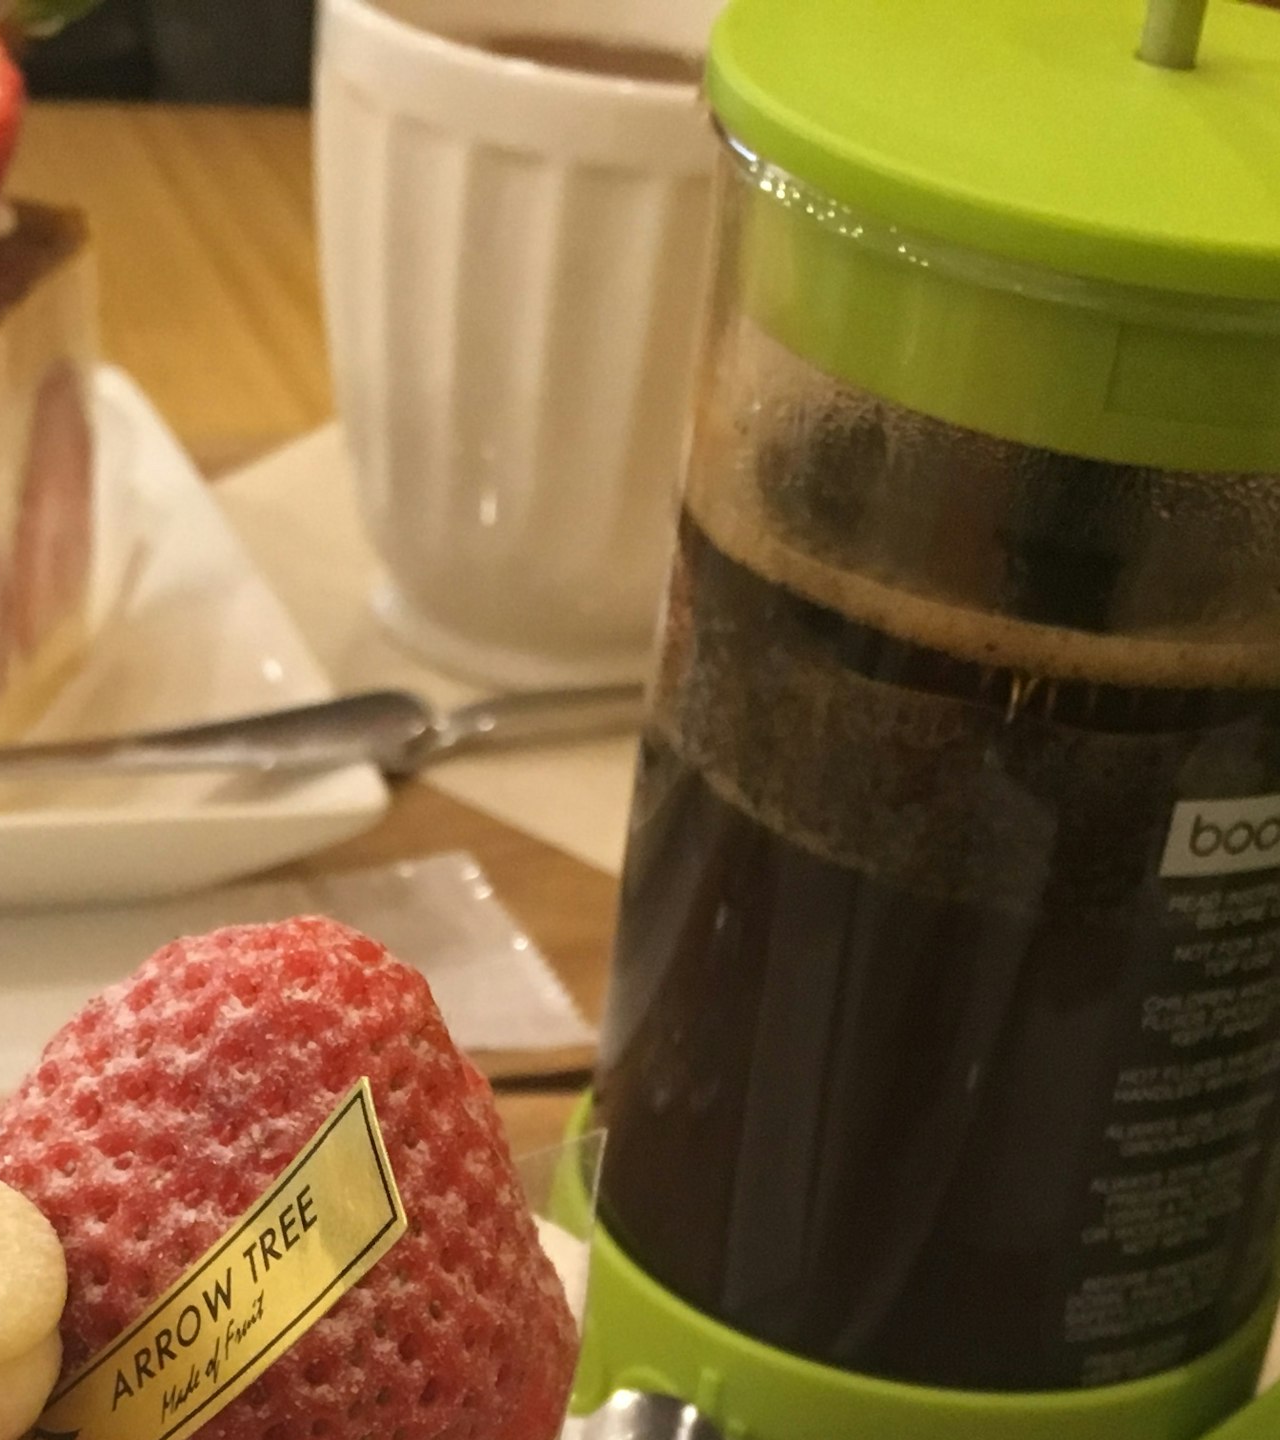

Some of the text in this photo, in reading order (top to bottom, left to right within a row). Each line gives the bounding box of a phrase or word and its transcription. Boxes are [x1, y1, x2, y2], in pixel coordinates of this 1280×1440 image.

[111, 1184, 318, 1412] ARROW TREE
[161, 1289, 265, 1424] Made of Fruit
